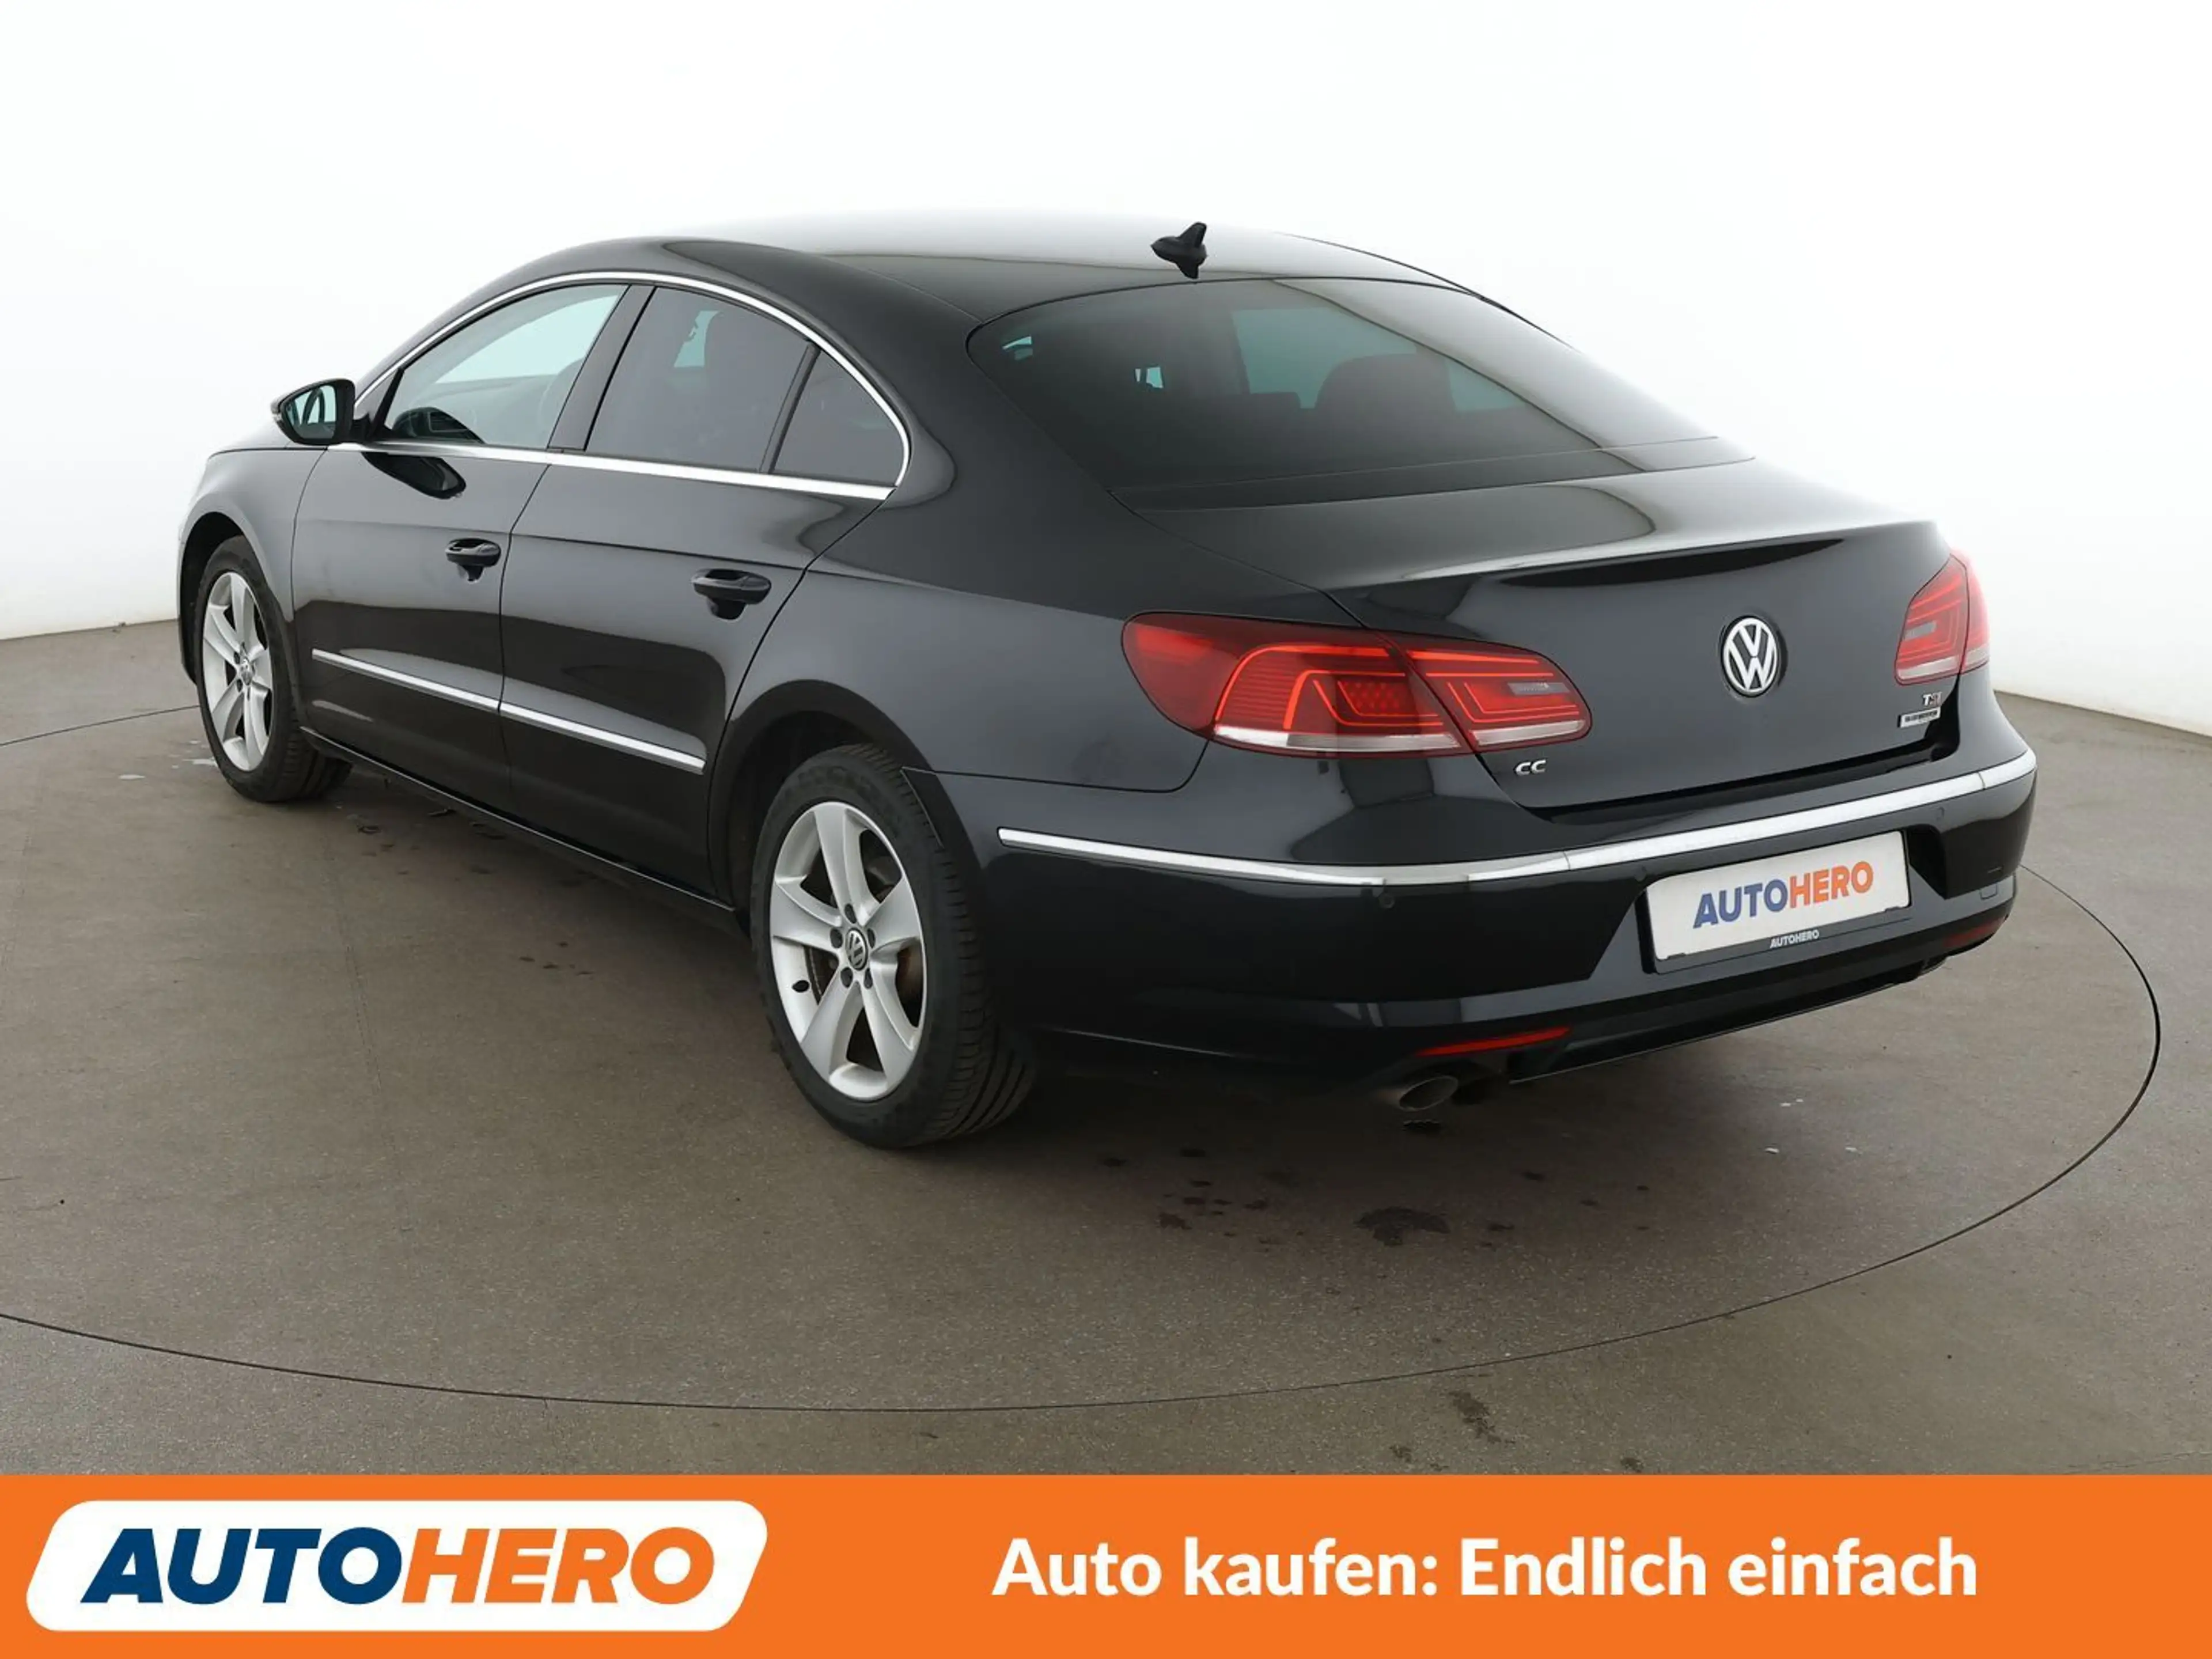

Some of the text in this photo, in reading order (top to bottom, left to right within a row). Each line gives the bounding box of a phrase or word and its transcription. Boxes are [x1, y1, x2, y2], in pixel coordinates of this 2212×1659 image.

[1516, 759, 1547, 776] CC
[1692, 861, 1874, 929] AUTOHERO
[1769, 929, 1820, 949] AUTOHERO
